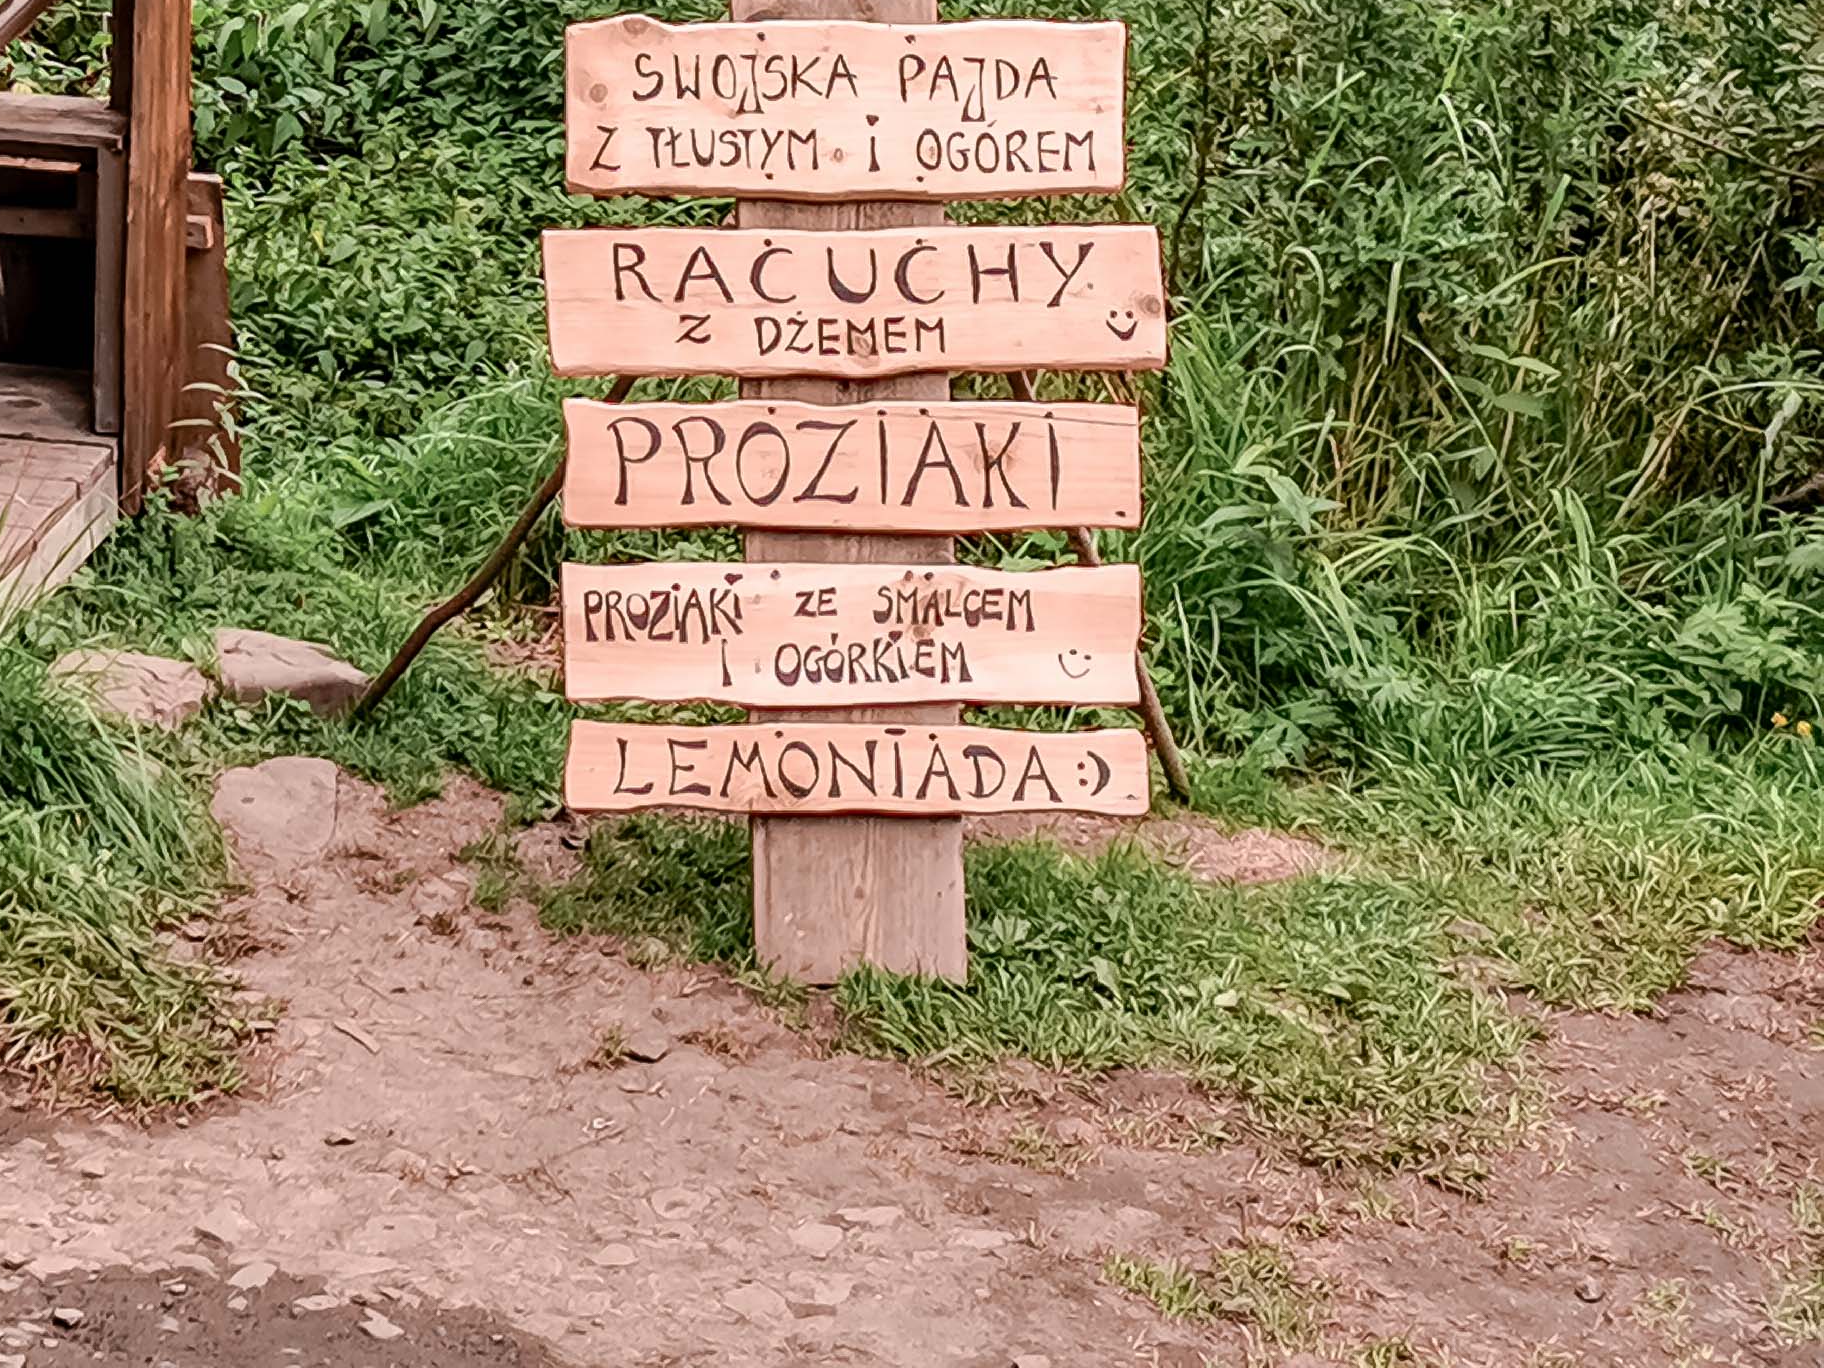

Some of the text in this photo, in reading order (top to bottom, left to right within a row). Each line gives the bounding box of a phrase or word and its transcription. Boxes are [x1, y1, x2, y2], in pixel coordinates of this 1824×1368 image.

[632, 53, 1058, 122] SWOJSKA PAJDA
[589, 125, 622, 172] Z
[646, 125, 819, 173] TŁUSTYM
[916, 120, 1097, 174] OGÓREM
[612, 239, 1096, 308] RACUCHY
[754, 312, 947, 356] DŻEMEM
[606, 414, 1062, 510] PROZIAKI
[794, 587, 839, 618] ZE
[872, 585, 1037, 631] SMALCEM
